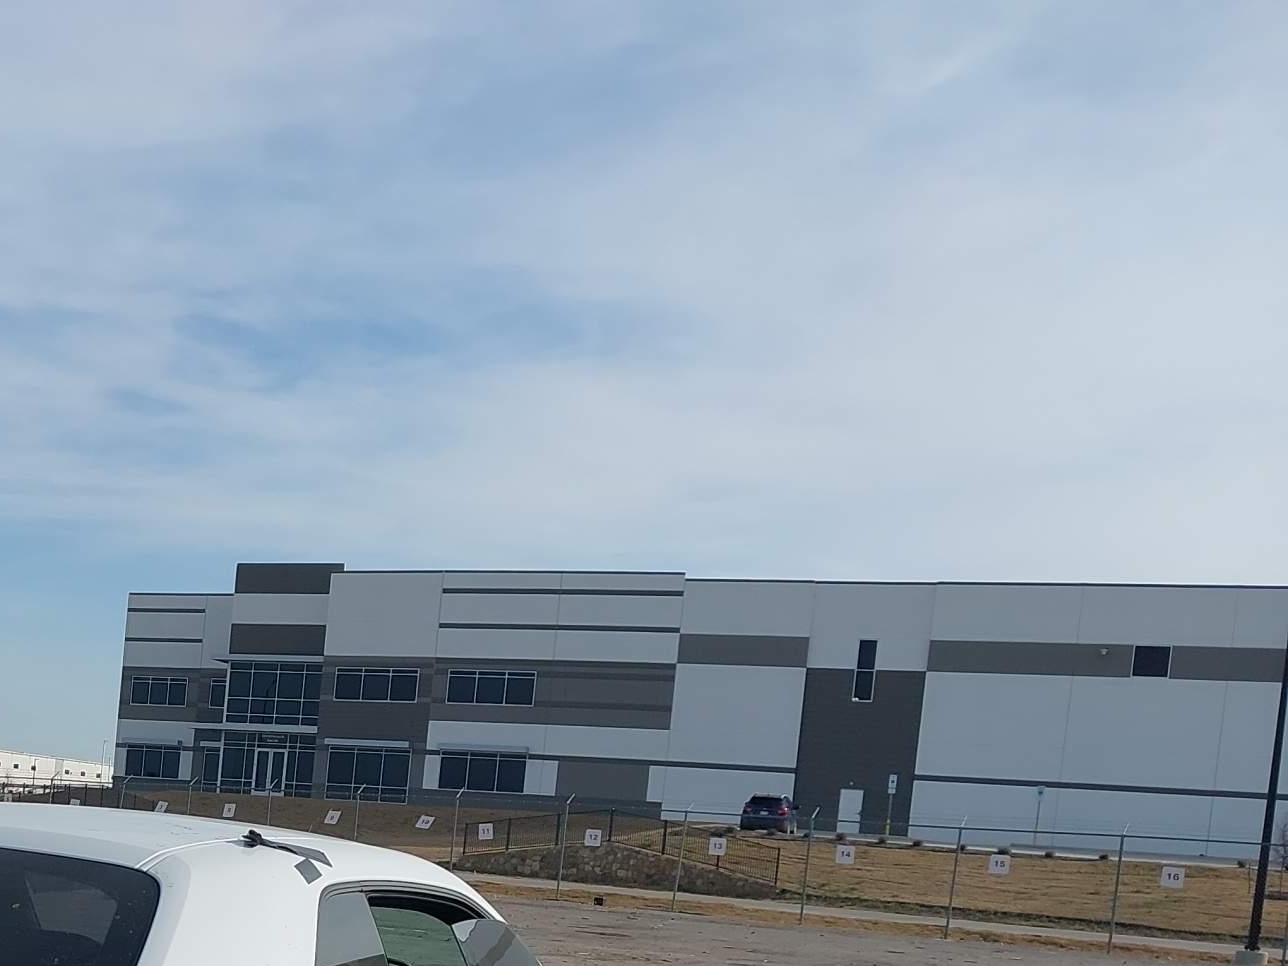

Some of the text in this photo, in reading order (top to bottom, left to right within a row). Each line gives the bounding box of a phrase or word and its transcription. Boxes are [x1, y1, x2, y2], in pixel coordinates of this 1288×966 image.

[713, 842, 723, 850] 13
[841, 850, 851, 858] 14
[995, 859, 1006, 868] 15
[1167, 872, 1181, 881] 16
